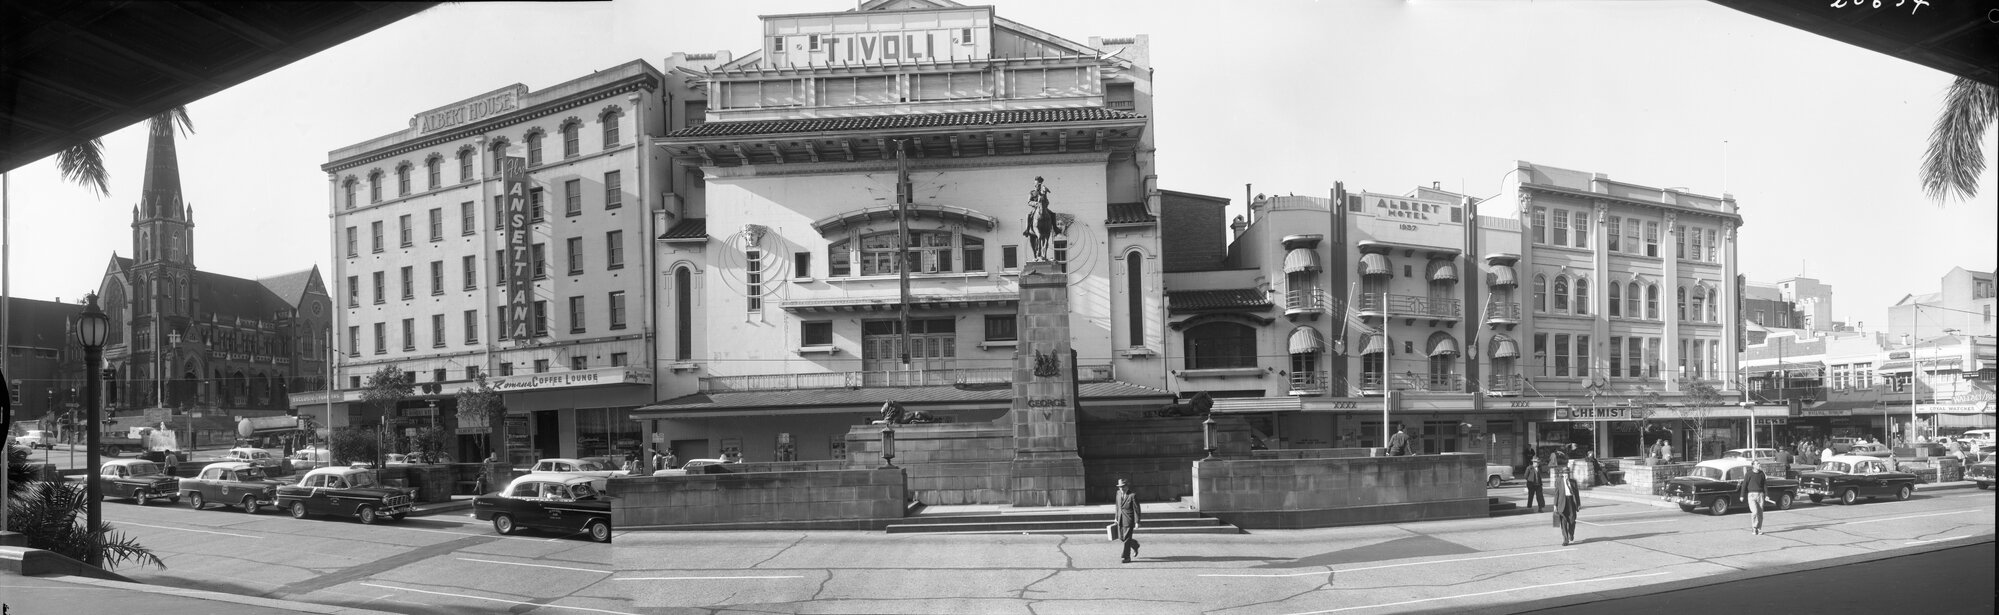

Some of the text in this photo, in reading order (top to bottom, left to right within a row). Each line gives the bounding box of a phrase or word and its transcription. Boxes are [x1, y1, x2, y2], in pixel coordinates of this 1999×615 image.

[822, 34, 934, 62] TIVOLI
[421, 106, 465, 134] ALBERT
[507, 158, 525, 178] Fly
[1377, 198, 1440, 213] ALBERT
[1388, 209, 1427, 219] HOTEL
[509, 182, 528, 338] ANSETT-ANA
[566, 374, 598, 385] LOUNGE
[1028, 399, 1067, 407] GEORGE
[1334, 401, 1357, 409] XXXX
[1043, 412, 1051, 420] V
[1572, 408, 1626, 418] CHEMIST
